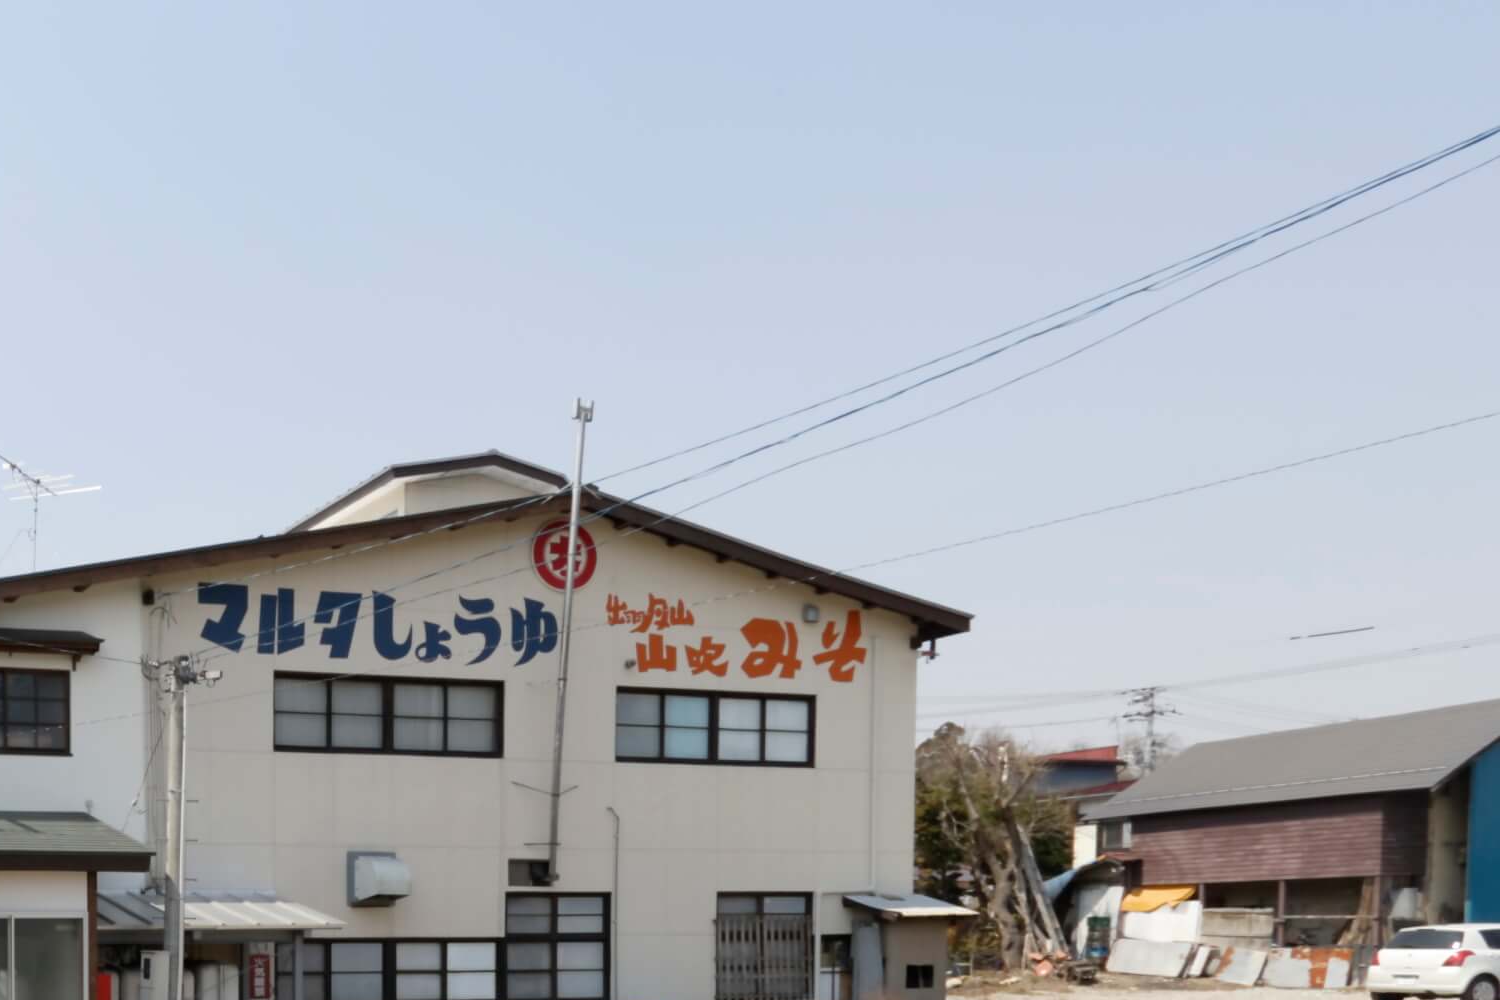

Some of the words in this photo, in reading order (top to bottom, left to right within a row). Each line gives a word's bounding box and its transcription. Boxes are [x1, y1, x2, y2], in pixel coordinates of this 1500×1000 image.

[197, 582, 559, 667] マルタしょうゆ
[635, 610, 867, 682] 山吹みそ
